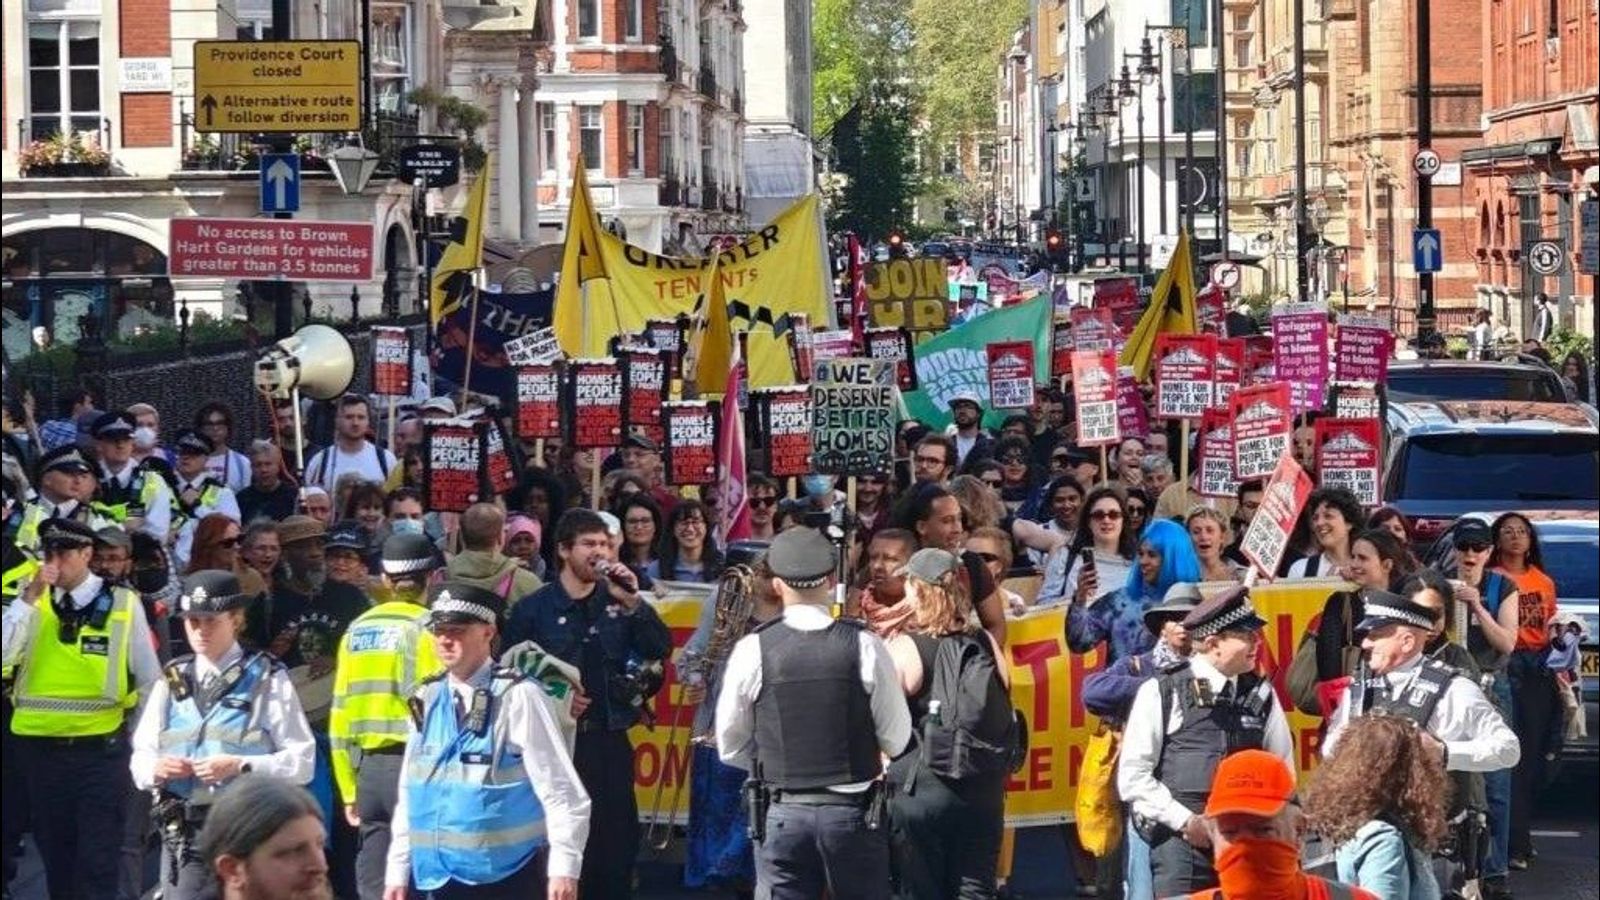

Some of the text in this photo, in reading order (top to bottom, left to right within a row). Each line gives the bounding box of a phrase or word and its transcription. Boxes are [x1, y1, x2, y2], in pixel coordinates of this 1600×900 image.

[211, 47, 344, 62] Providence Court
[124, 61, 158, 71] GEORGE
[252, 64, 302, 77] closed
[223, 94, 354, 107] Alternative route
[228, 109, 350, 123] follow diversion
[1416, 157, 1437, 169] 20
[197, 225, 348, 241] No access to Brown
[177, 242, 368, 258] Hart Gardens for vehicles
[183, 259, 360, 274] greater than 3.5 tonnes
[655, 268, 758, 299] TENNTS
[866, 258, 947, 300] JOIN
[1278, 321, 1322, 333] Refugees
[1278, 332, 1312, 343] are not
[1341, 332, 1384, 345] Refugees
[376, 347, 409, 358] PEOPLE
[1279, 343, 1320, 354] to blame
[1358, 345, 1374, 354] not
[1280, 355, 1320, 367] Stop the
[1341, 354, 1380, 365] to blame
[630, 362, 655, 371] OMES
[519, 374, 559, 384] HOMES 4
[577, 374, 622, 385] HOMES 4
[630, 371, 664, 382] EOPLE
[832, 363, 872, 384] WE
[518, 384, 559, 396] PEOPLE
[577, 385, 622, 398] PEOPLE
[1162, 382, 1208, 392] HOMES FOR
[577, 398, 621, 406] NOT PROFIT
[815, 387, 891, 407] DESERVE
[1162, 392, 1191, 403] PEOPLE
[1193, 392, 1209, 403] NOT
[1337, 397, 1379, 407] HOMES 4
[771, 402, 805, 414] HOMES
[1162, 403, 1207, 413] FOR PROFIT
[1337, 407, 1379, 418] PEOPLE
[671, 415, 713, 426] HOMES 4
[770, 412, 812, 426] PEOPL
[815, 408, 892, 428] BETTER
[671, 426, 714, 438] PEOPLE
[771, 426, 812, 435] NOT PROFI
[431, 437, 479, 449] HOMES 4
[671, 438, 713, 447] NOT PROFIT
[815, 430, 888, 452] HOMES
[1238, 436, 1285, 453] HOMES FOR
[431, 448, 480, 462] PEOPLE
[1239, 450, 1270, 464] PEOPLE
[431, 462, 479, 471] NOT PROFIT
[1239, 464, 1256, 475] FOR
[1323, 471, 1372, 480] HOMES FOR
[1204, 481, 1240, 493] FOR PRO
[1358, 481, 1374, 491] NOT
